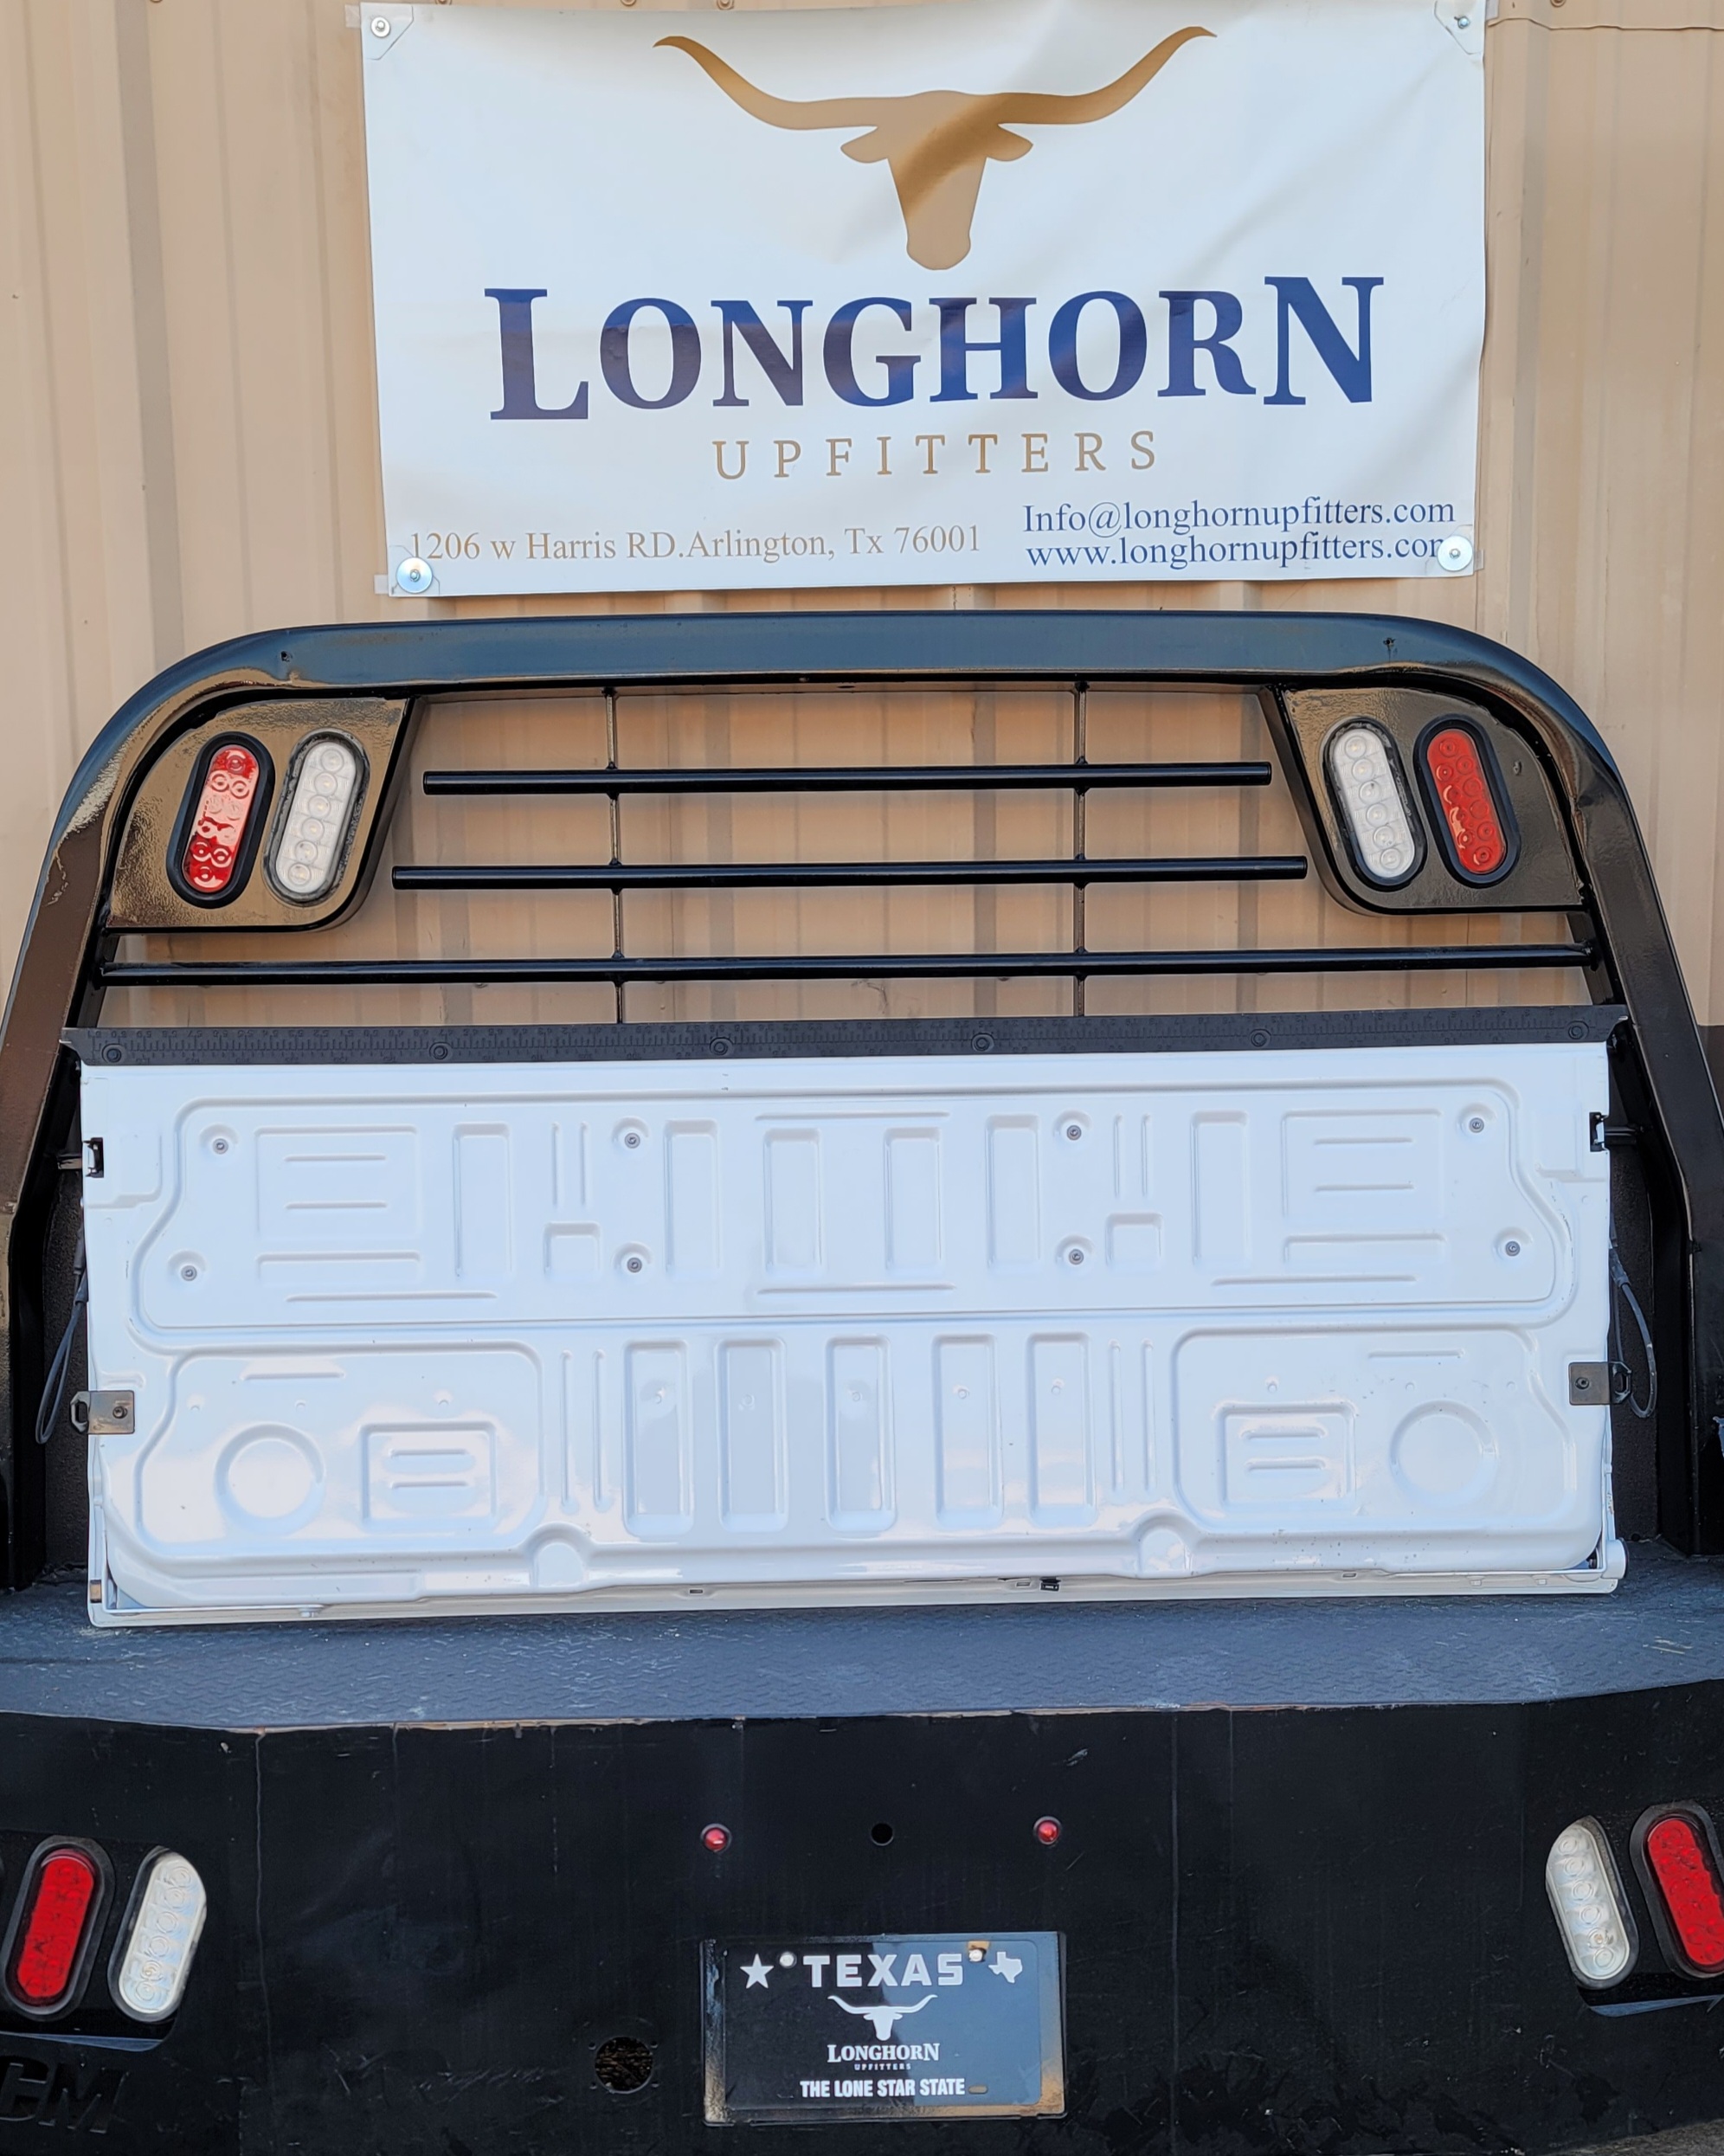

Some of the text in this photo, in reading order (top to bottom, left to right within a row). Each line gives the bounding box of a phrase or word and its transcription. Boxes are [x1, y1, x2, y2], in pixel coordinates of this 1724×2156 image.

[485, 276, 1385, 421] LONGHORN
[711, 430, 1158, 480] UPFITTERS
[1023, 496, 1457, 538] Info@longhornupfitters.com
[411, 531, 481, 560] 1206
[490, 540, 517, 560] w
[524, 531, 616, 560] Harris
[844, 528, 885, 556] Tx
[893, 525, 981, 555] 76001
[803, 1953, 963, 1987] TEXAS
[827, 2043, 941, 2063] LONGHORN
[853, 2063, 911, 2071] UPFITTERS
[800, 2078, 966, 2097] THE LONE STAR STATE
